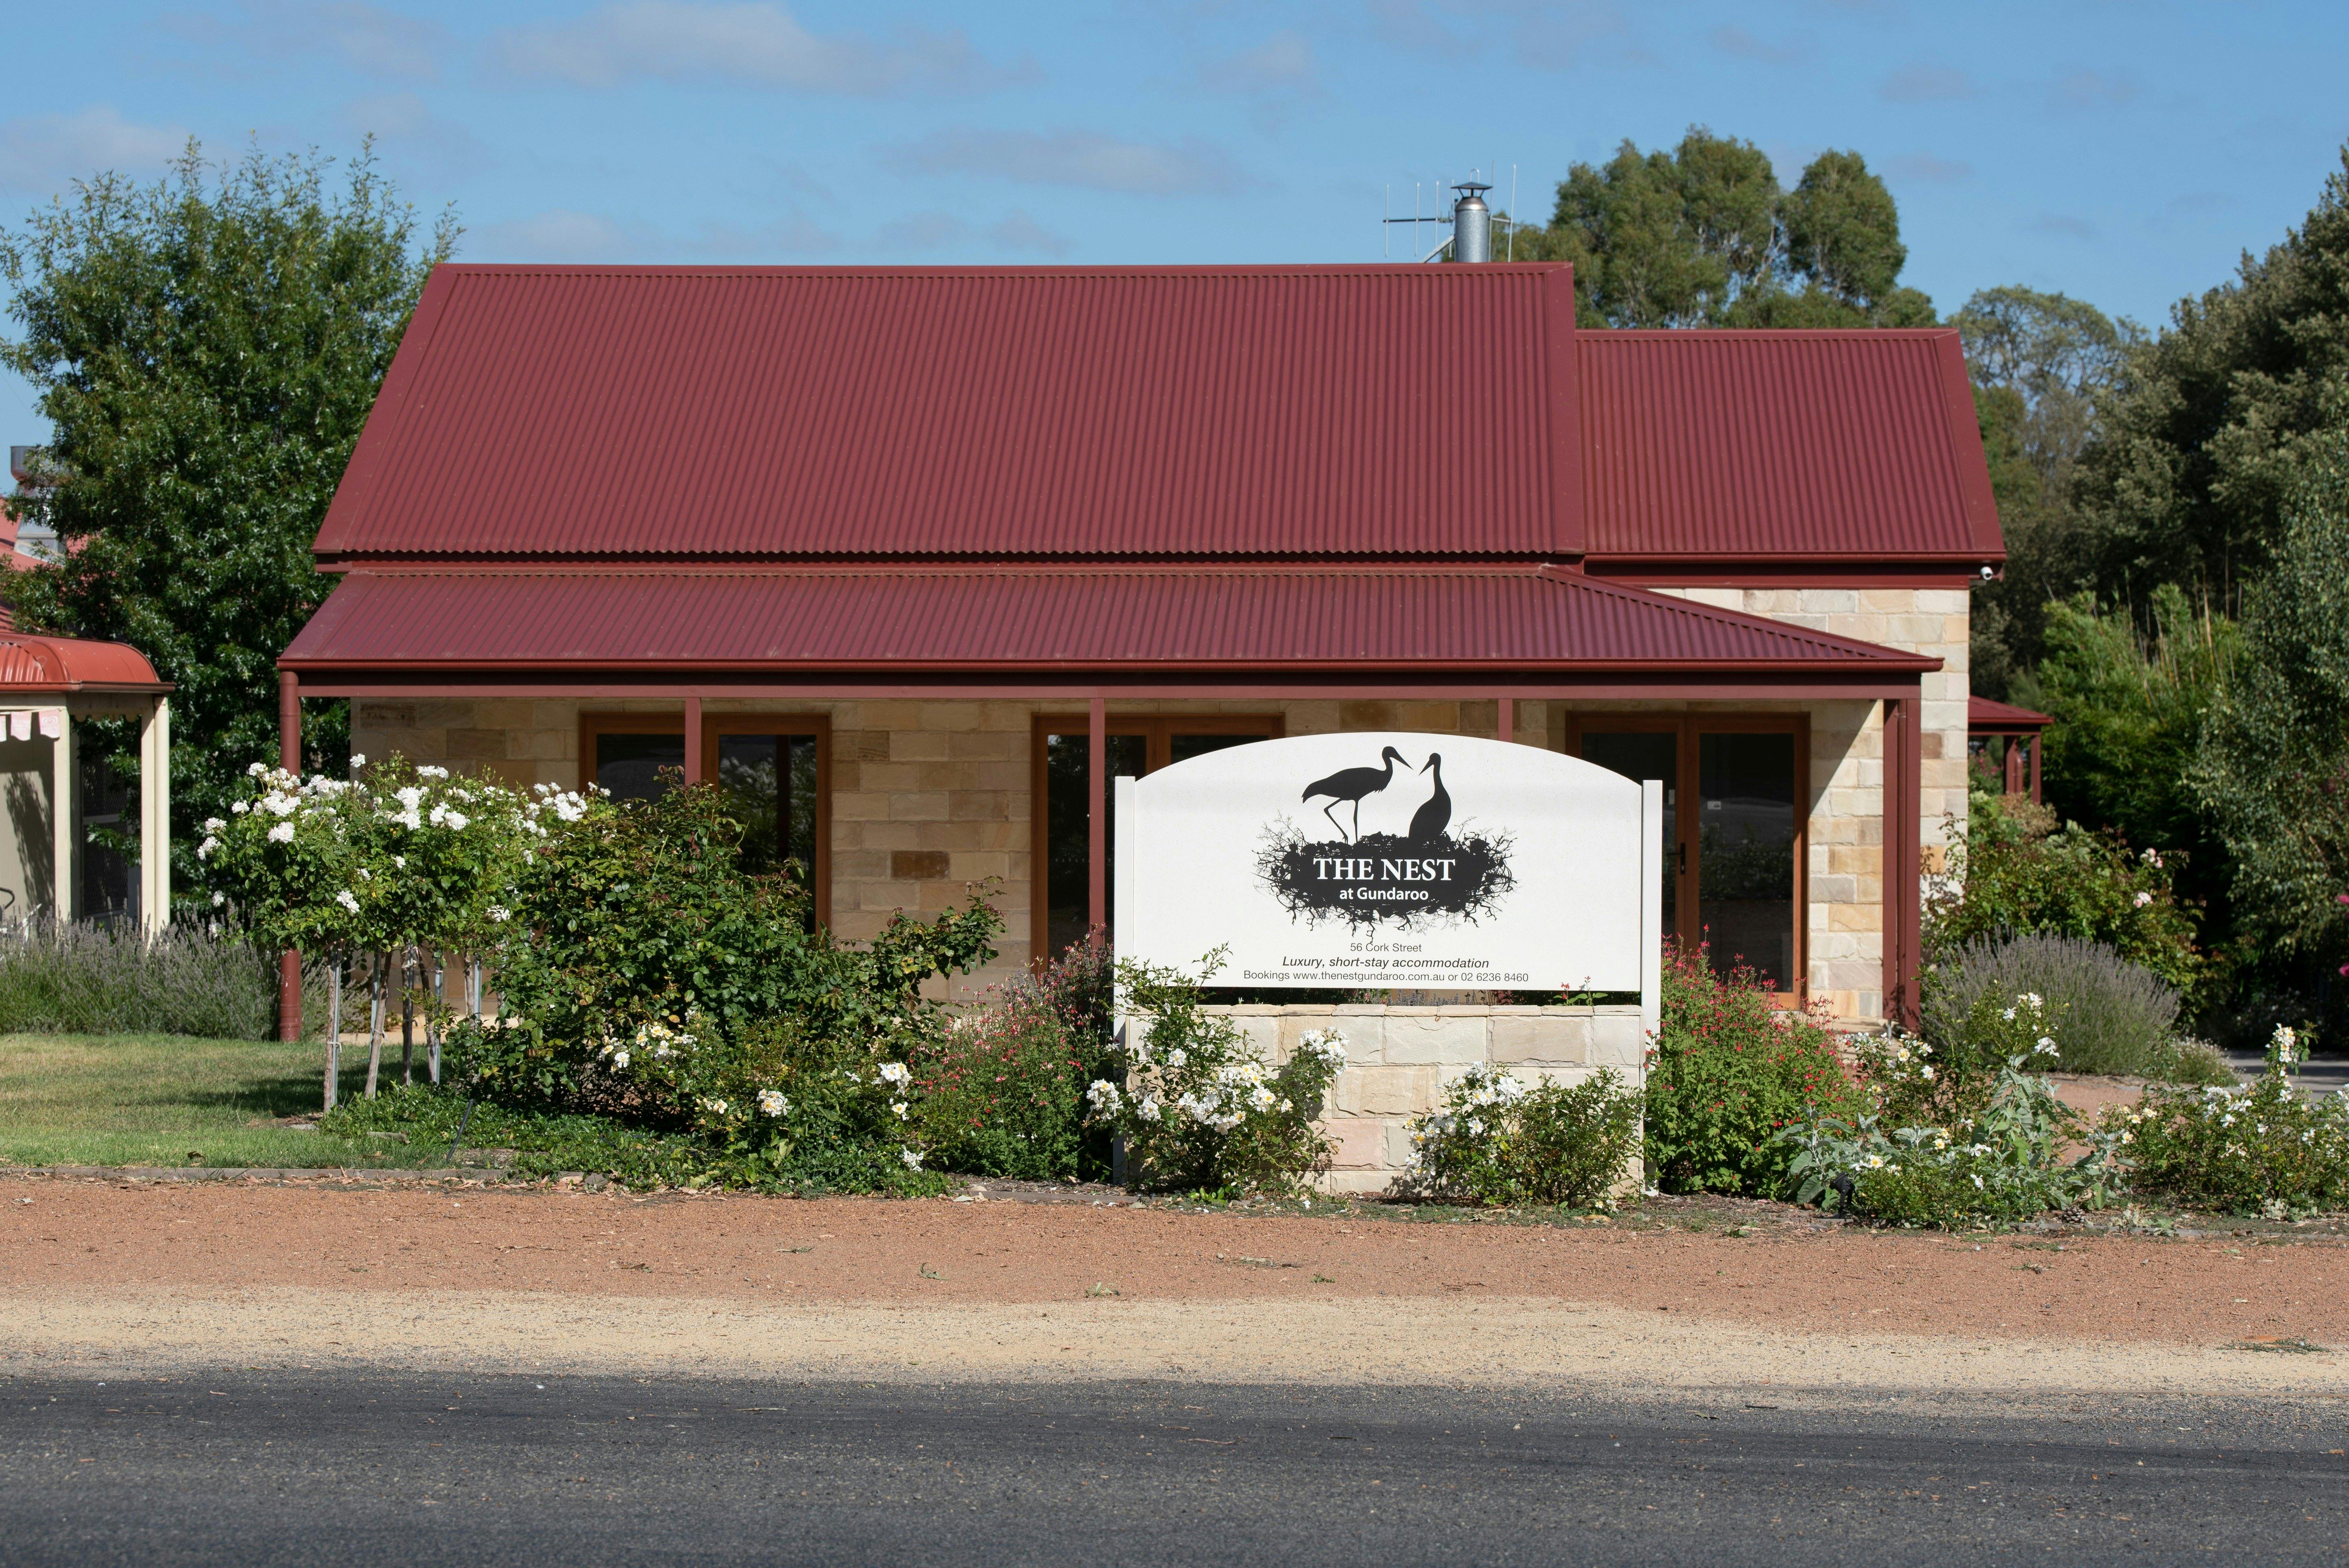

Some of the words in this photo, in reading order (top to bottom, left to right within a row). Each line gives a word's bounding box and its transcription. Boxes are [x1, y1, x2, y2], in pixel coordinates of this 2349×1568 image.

[1313, 858, 1374, 880] THE
[1381, 859, 1455, 881] NEST
[1340, 889, 1353, 900] at
[1357, 887, 1429, 900] Gundaroo
[1351, 943, 1362, 951] 56
[1366, 943, 1389, 952] Cork
[1393, 943, 1421, 952] Street
[1283, 956, 1325, 969] Luxury,
[1329, 957, 1389, 969] short-stay
[1392, 958, 1489, 968] accommodation
[1244, 971, 1290, 981] Bookings
[1293, 971, 1445, 982] www.thenestgundaroo.com.au
[1477, 973, 1500, 981] 6236
[1504, 973, 1528, 982] 8460
